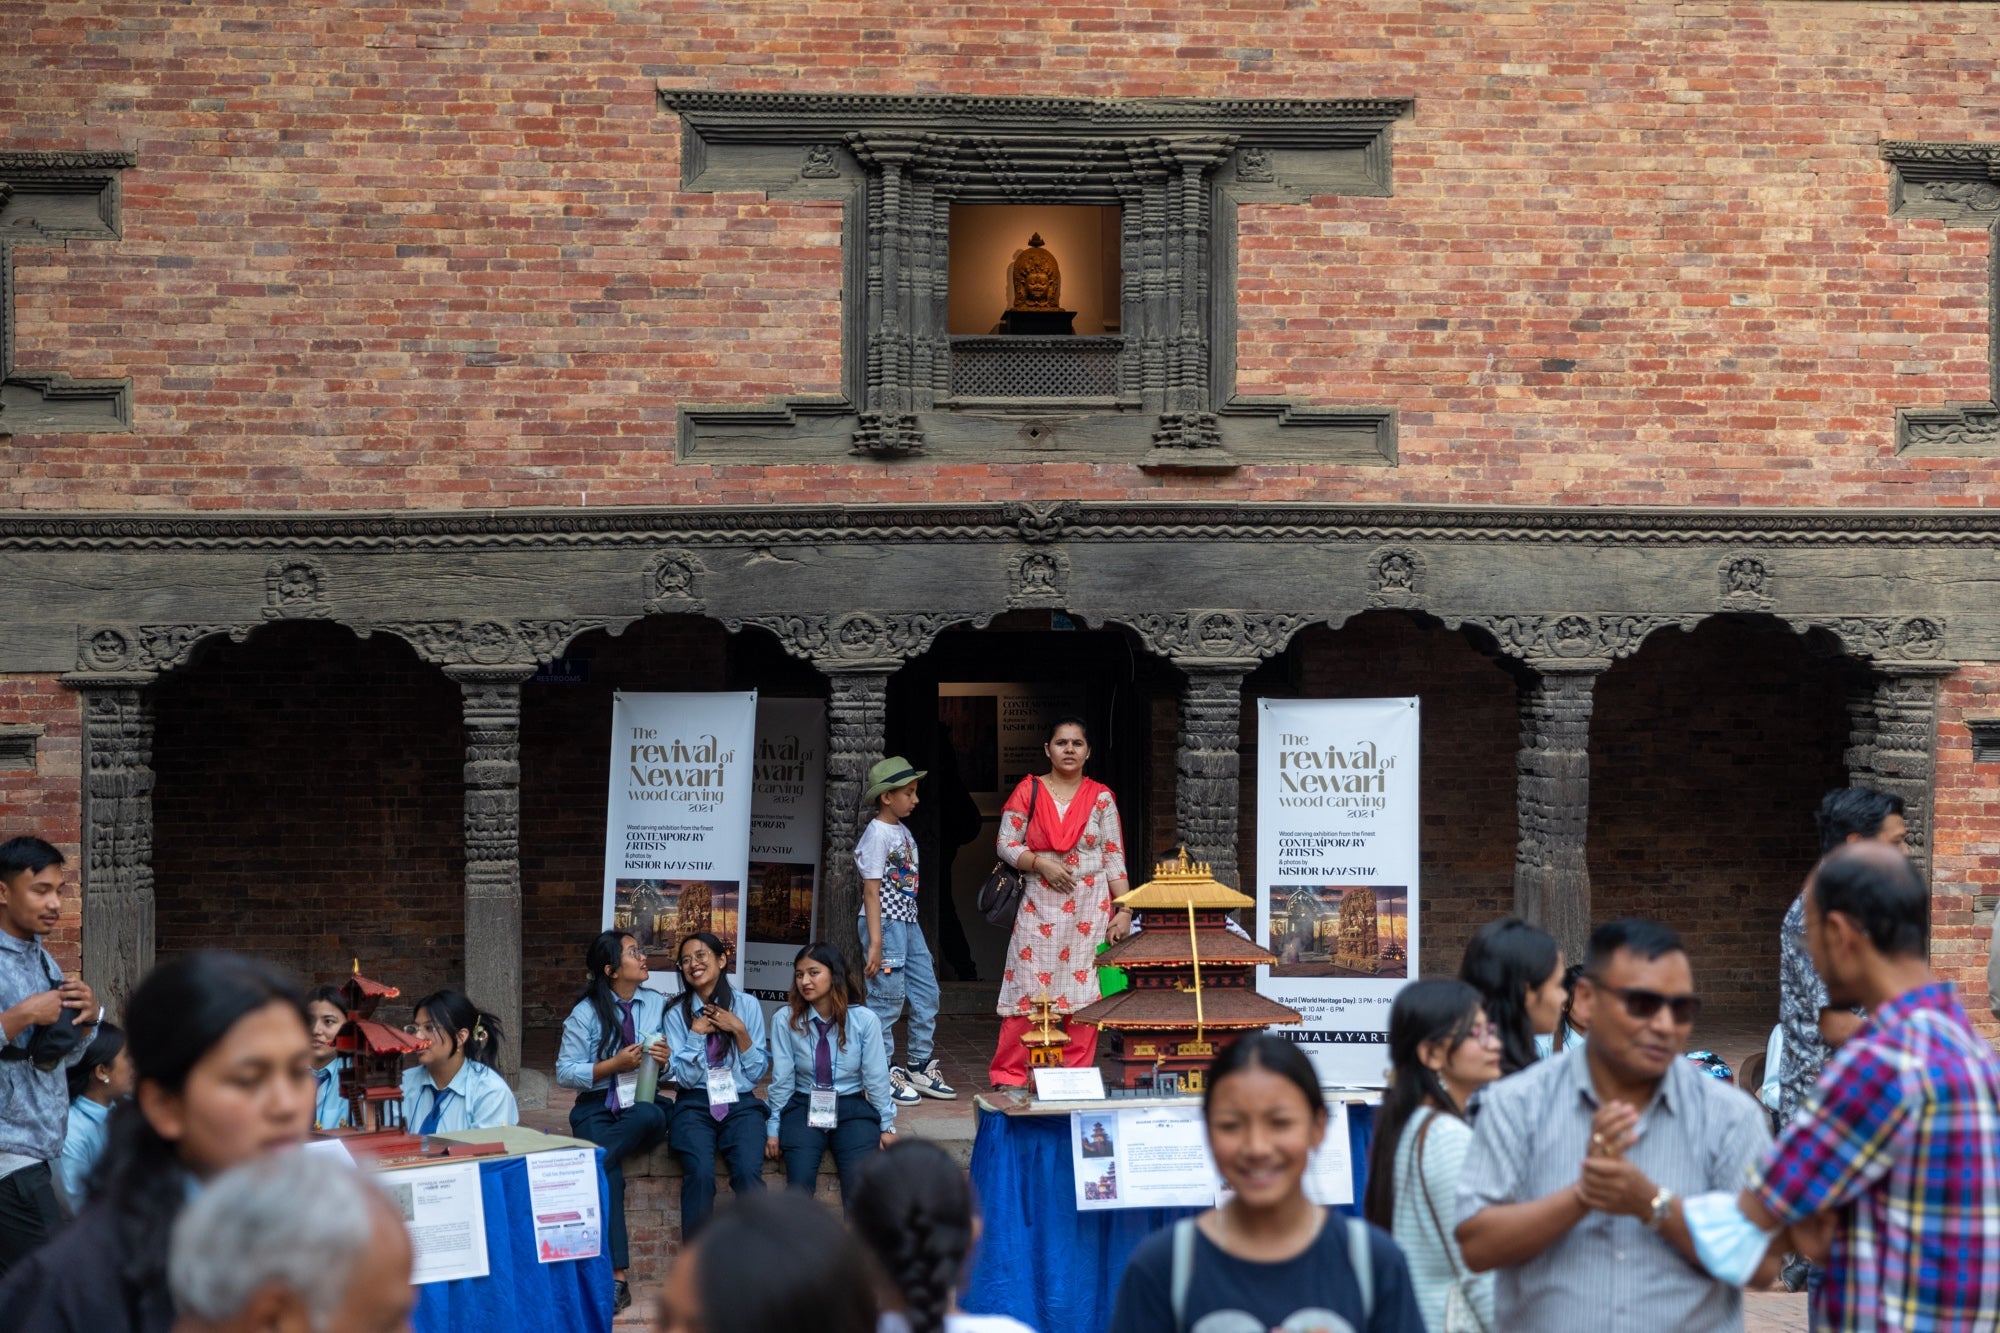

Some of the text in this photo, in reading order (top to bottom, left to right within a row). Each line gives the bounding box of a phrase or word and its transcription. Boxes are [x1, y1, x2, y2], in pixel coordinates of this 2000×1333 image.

[631, 727, 657, 739] The
[1279, 733, 1309, 746] The
[630, 734, 735, 763] revival of
[754, 735, 815, 760] vival of
[1280, 740, 1397, 769] revival of
[629, 763, 724, 787] Newari
[754, 761, 804, 781] wari
[1280, 769, 1385, 793] Newari
[758, 783, 804, 796] carving
[628, 789, 724, 805] wood carving
[773, 796, 795, 804] 2024
[1279, 794, 1386, 811] wood carving
[688, 804, 714, 813] 2024
[1347, 809, 1375, 819] 2024
[626, 832, 705, 841] CONTEMPORARY
[626, 842, 667, 850] ARTISTS
[1279, 838, 1366, 847] CONTEMPORARY
[751, 845, 794, 854] KAYASTHA
[1279, 848, 1324, 857] ARTISTS
[625, 860, 715, 870] KISHOR KAYASTHA
[1279, 867, 1379, 876] KISHOR KAYASTHA
[1298, 996, 1316, 1004] (World
[1279, 1032, 1389, 1042] HIMALAY'ART
